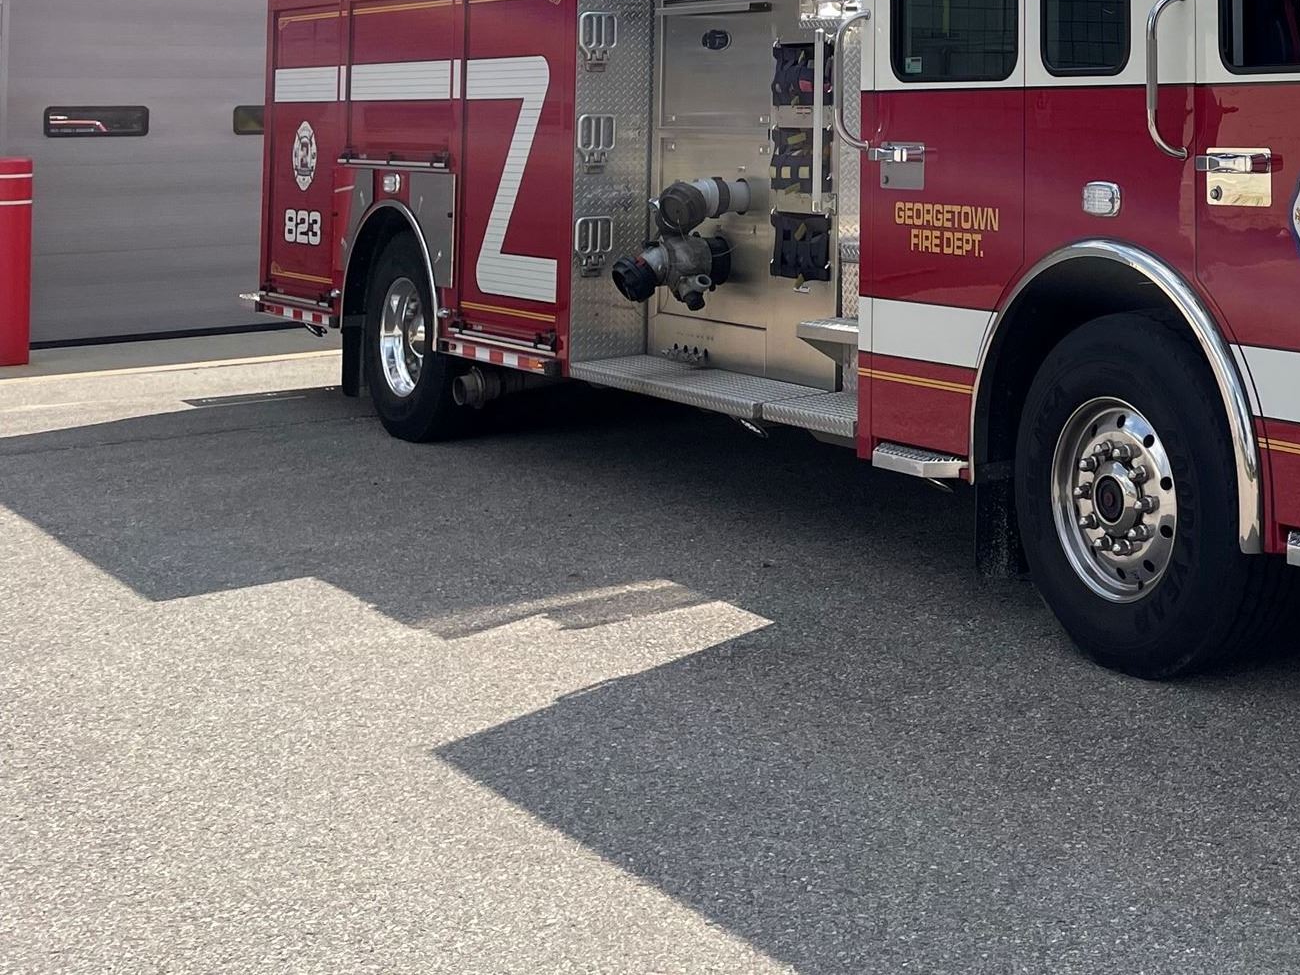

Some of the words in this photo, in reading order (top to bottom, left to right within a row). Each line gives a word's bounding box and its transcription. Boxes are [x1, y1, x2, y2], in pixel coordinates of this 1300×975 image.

[284, 208, 322, 246] 823
[895, 201, 999, 231] GEORGETOWN
[910, 228, 941, 254] FIRE
[943, 230, 984, 258] DEPT.
